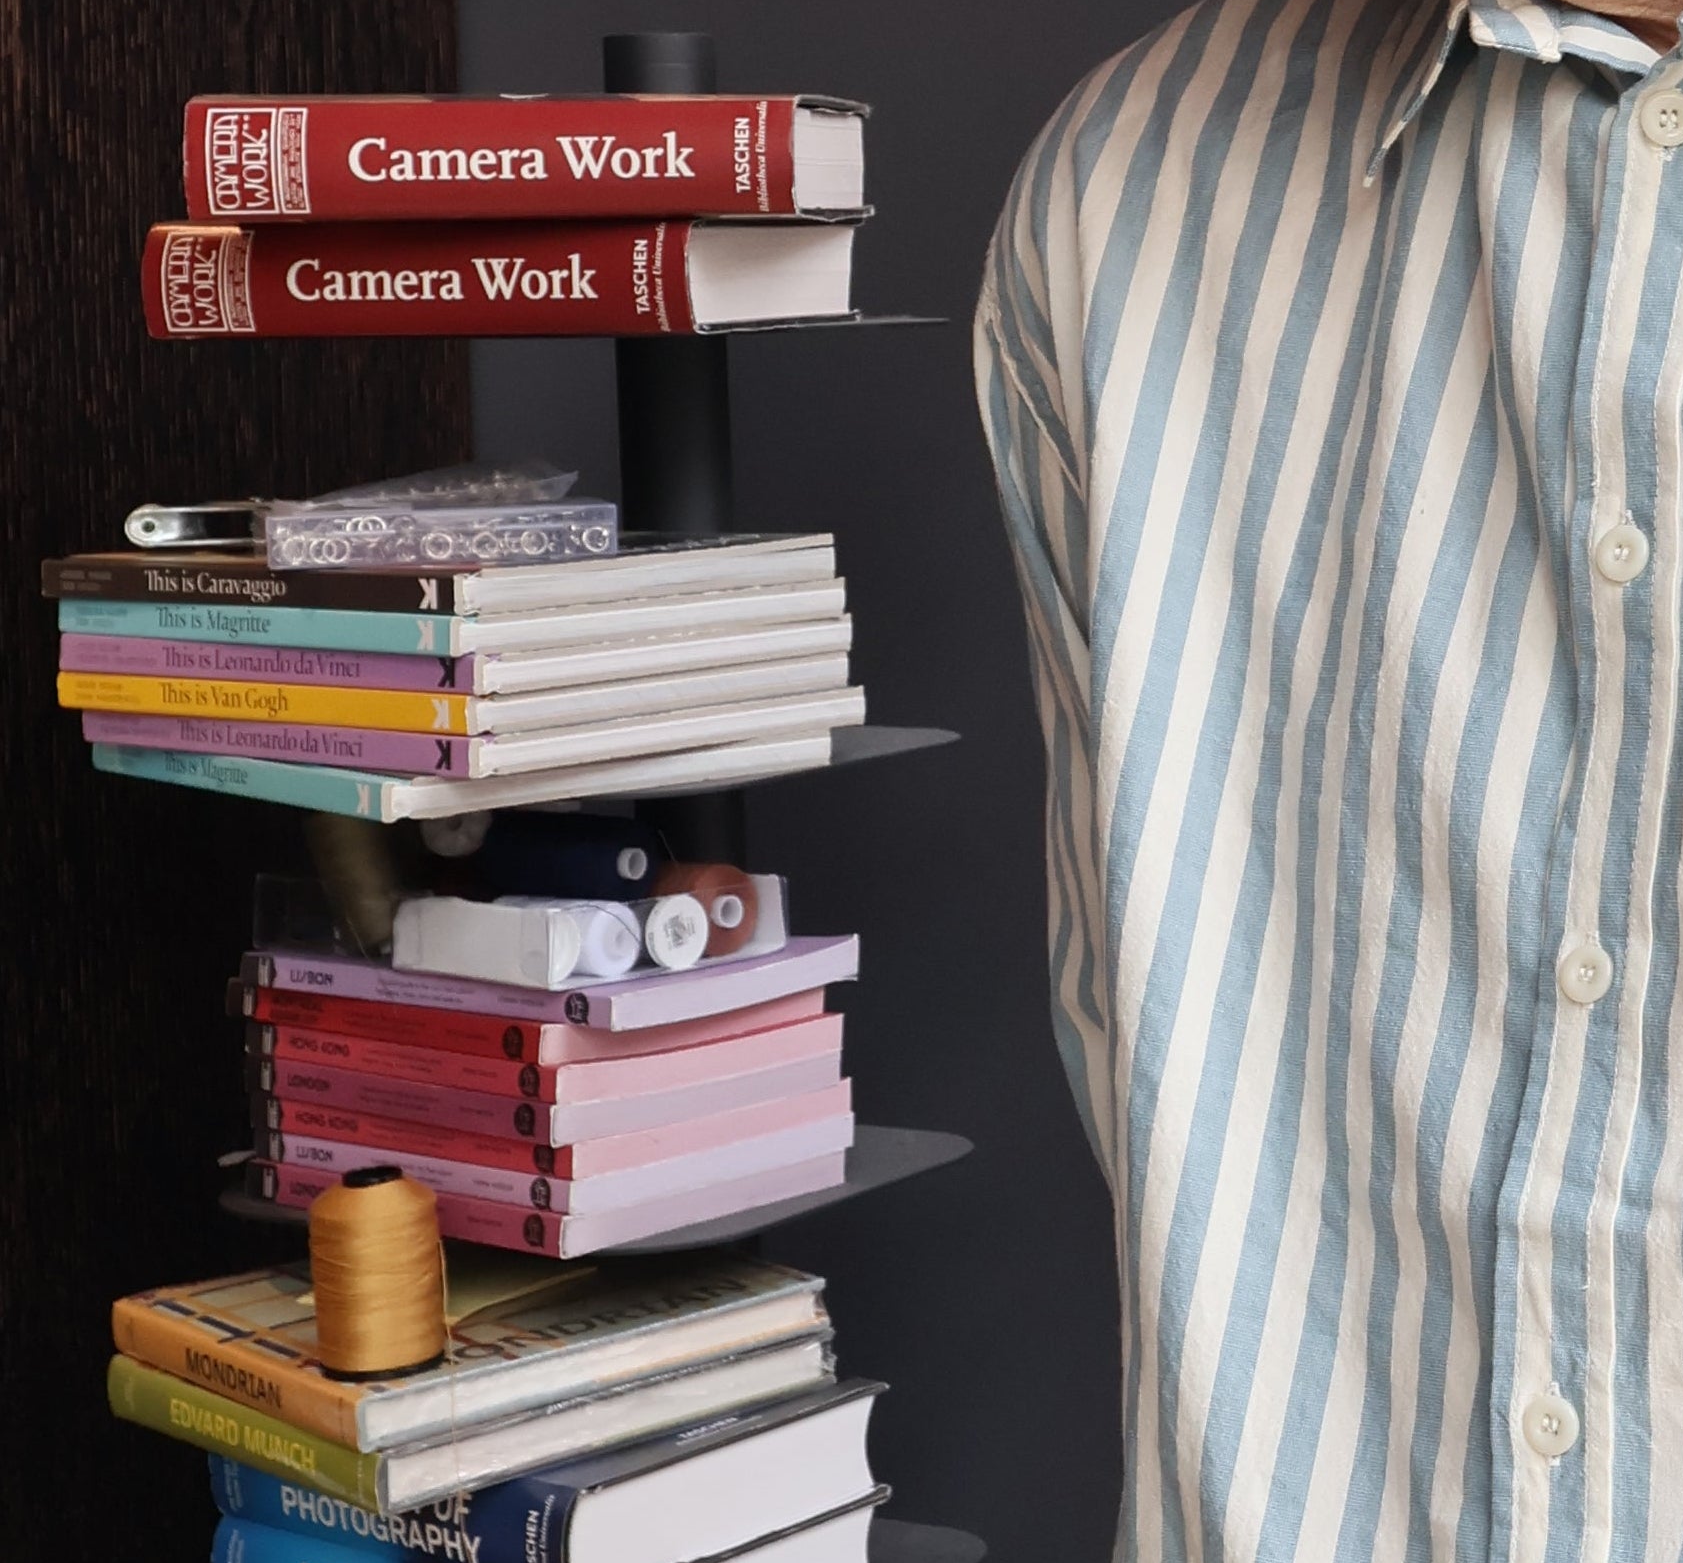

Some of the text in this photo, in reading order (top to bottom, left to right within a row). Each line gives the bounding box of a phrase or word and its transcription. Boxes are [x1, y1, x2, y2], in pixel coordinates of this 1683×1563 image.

[348, 137, 548, 181] Camera
[556, 131, 695, 179] Work
[735, 117, 751, 193] TASCHEN
[755, 101, 770, 212] Bibliotheca Universalis
[286, 259, 464, 301] Camera
[471, 254, 598, 300] Work
[633, 239, 650, 314] TASCHEN
[145, 569, 287, 602] This is Caravaggio
[156, 606, 271, 637] This is Magritte
[163, 646, 195, 667] This
[199, 649, 211, 669] is
[214, 649, 290, 676] Leonardo
[294, 655, 313, 675] da
[314, 654, 360, 678] Vinci
[159, 682, 192, 704] This
[195, 685, 207, 705] is
[211, 686, 241, 708] Van
[244, 688, 288, 717] Gogh
[178, 720, 208, 743] This
[211, 724, 223, 744] is
[226, 725, 297, 753] Leonardo
[300, 732, 319, 754] da
[319, 733, 363, 758] Vinci
[164, 754, 187, 774] This
[189, 758, 198, 775] is
[201, 759, 248, 785] Magritte
[287, 1073, 331, 1091] LONDON
[444, 1279, 746, 1365] ONDRIAN
[185, 1347, 283, 1410] MONDRIAN
[169, 1398, 317, 1476] EDVARD MUNCH
